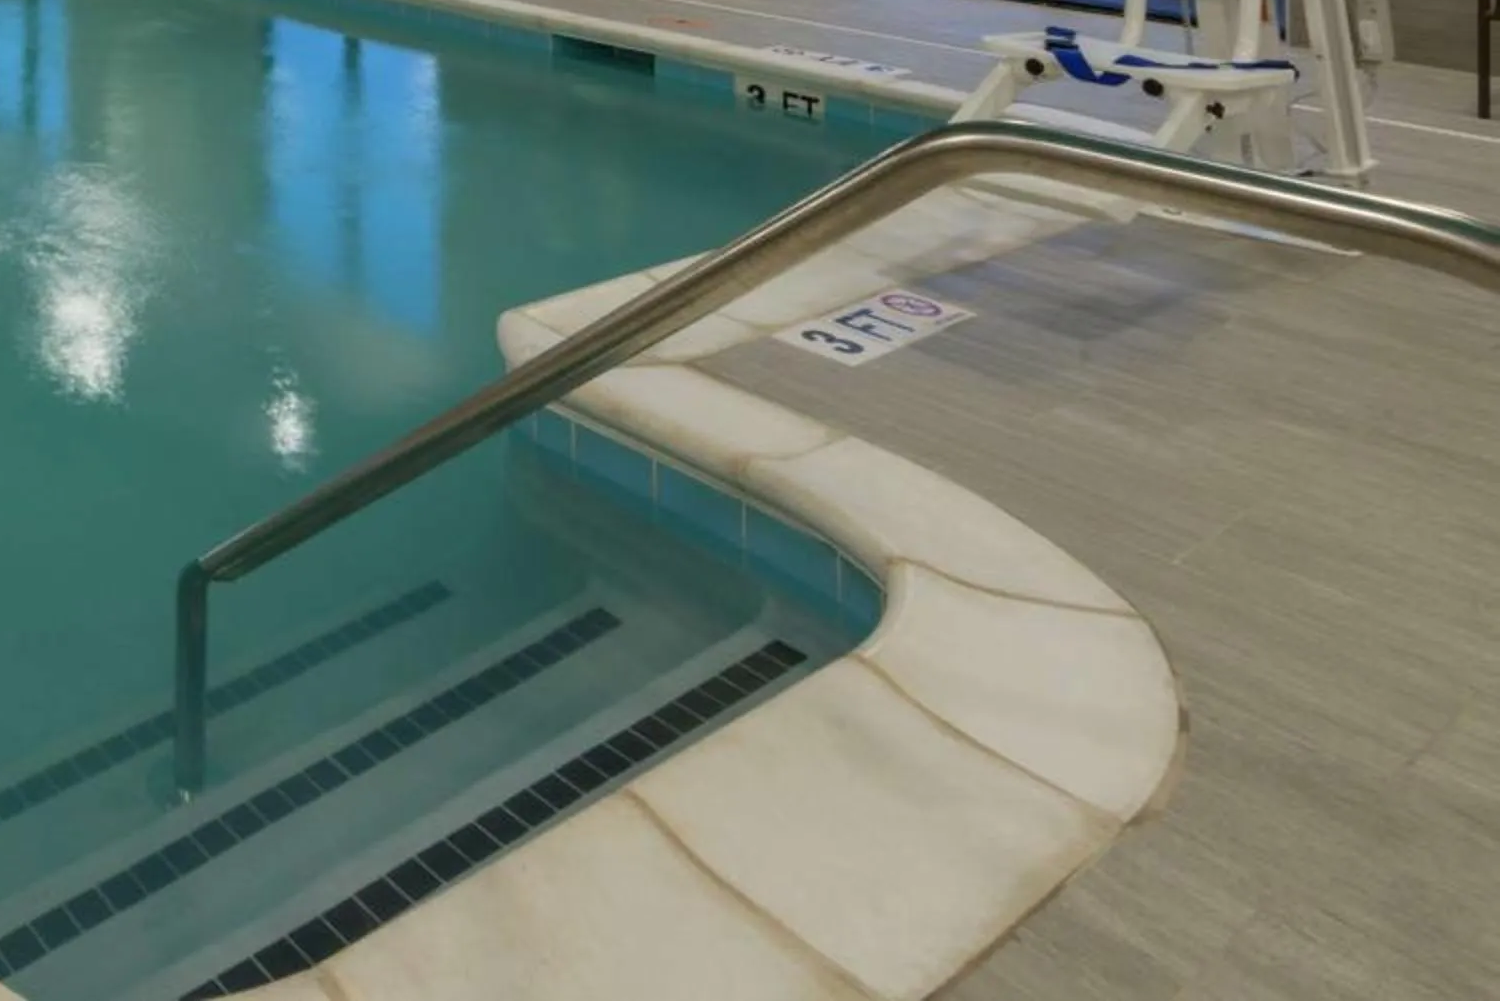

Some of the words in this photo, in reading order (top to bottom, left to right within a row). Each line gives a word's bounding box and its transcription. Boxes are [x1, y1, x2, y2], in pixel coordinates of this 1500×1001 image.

[782, 90, 820, 118] FT
[802, 329, 865, 355] 3
[836, 308, 916, 342] FT
